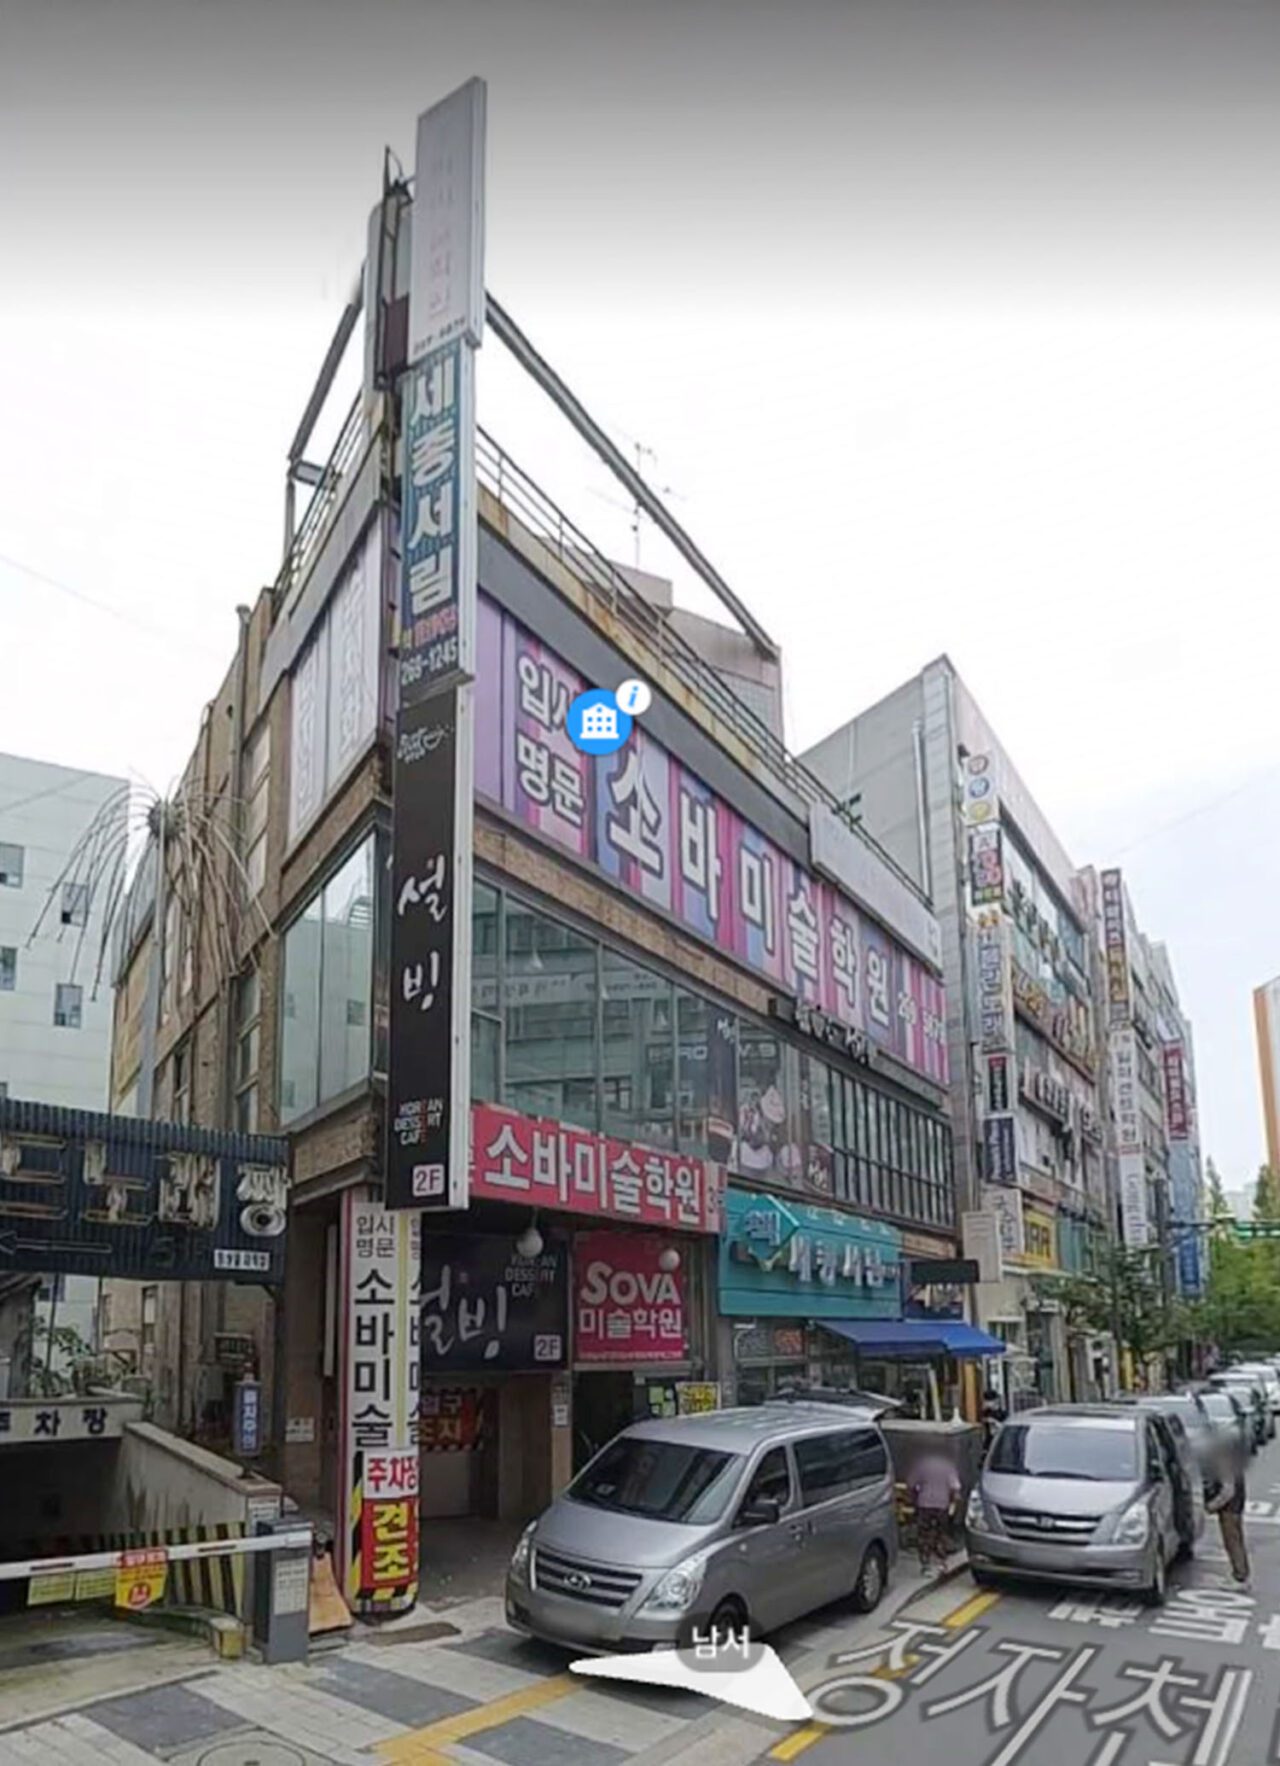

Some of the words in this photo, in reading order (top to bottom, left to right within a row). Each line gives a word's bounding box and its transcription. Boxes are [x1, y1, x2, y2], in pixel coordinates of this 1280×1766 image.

[409, 354, 457, 618] 세종서림
[517, 732, 584, 828] 명문
[605, 745, 891, 1028] 소바미술학원
[415, 1169, 442, 1194] 2F
[483, 1123, 702, 1225] 소바미술학원
[354, 1214, 396, 1236] 입시
[354, 1237, 396, 1259] 명문
[579, 1260, 682, 1306] SOVA
[579, 1307, 682, 1340] 미술학원
[351, 1268, 396, 1450] 소바미술
[537, 1338, 560, 1358] 2F
[373, 1502, 419, 1543] 견
